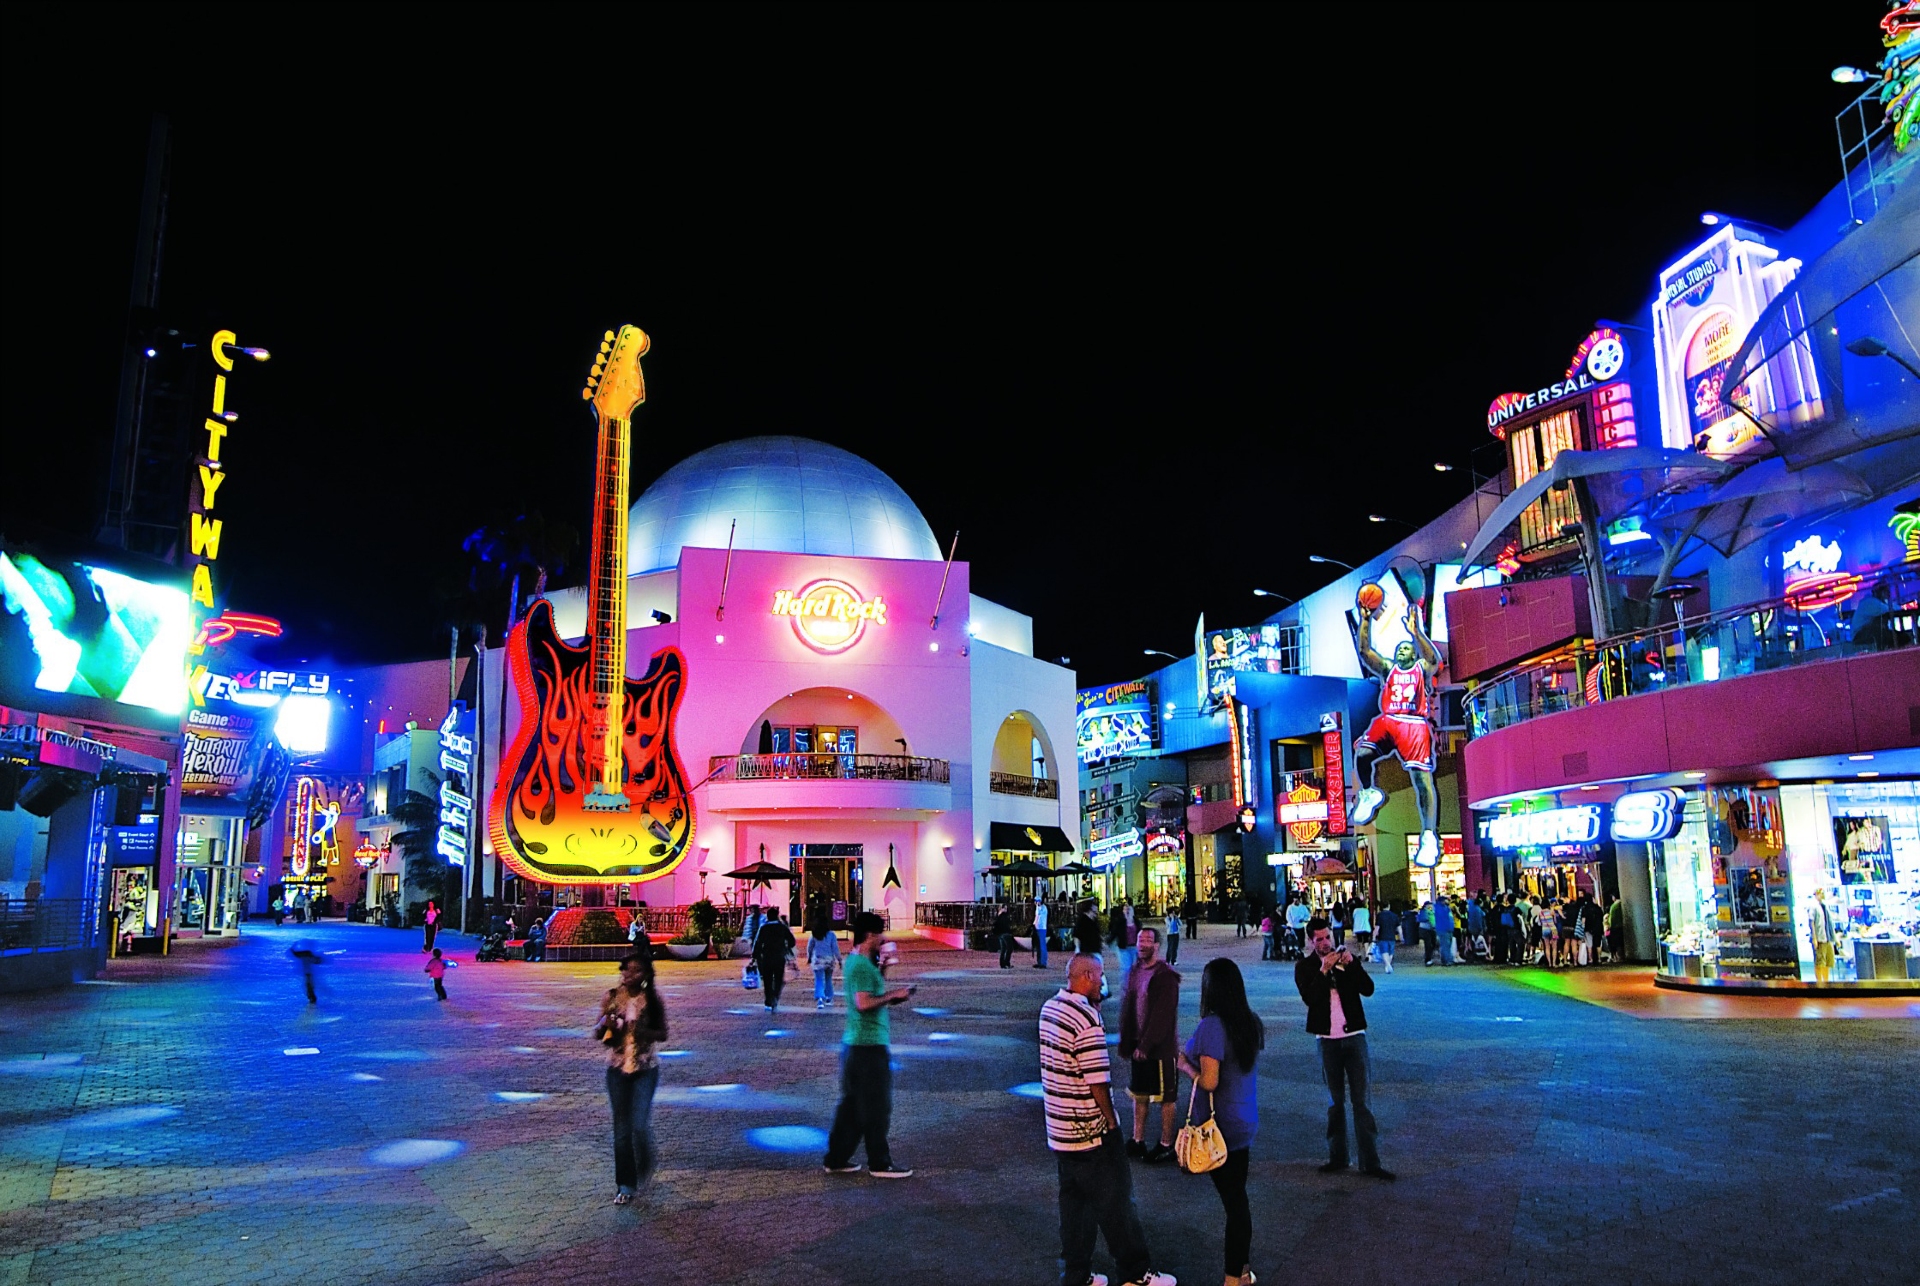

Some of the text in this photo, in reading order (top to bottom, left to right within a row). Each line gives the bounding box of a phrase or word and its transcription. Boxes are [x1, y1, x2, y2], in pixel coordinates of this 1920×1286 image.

[1687, 258, 1717, 285] STUDIOS
[1488, 373, 1592, 427] UNIVERSAL
[771, 589, 887, 625] Hard Rock
[1105, 682, 1145, 704] CITYWALK
[1390, 684, 1415, 702] 34
[188, 709, 254, 728] GameStop
[1292, 787, 1318, 803] MOTOR
